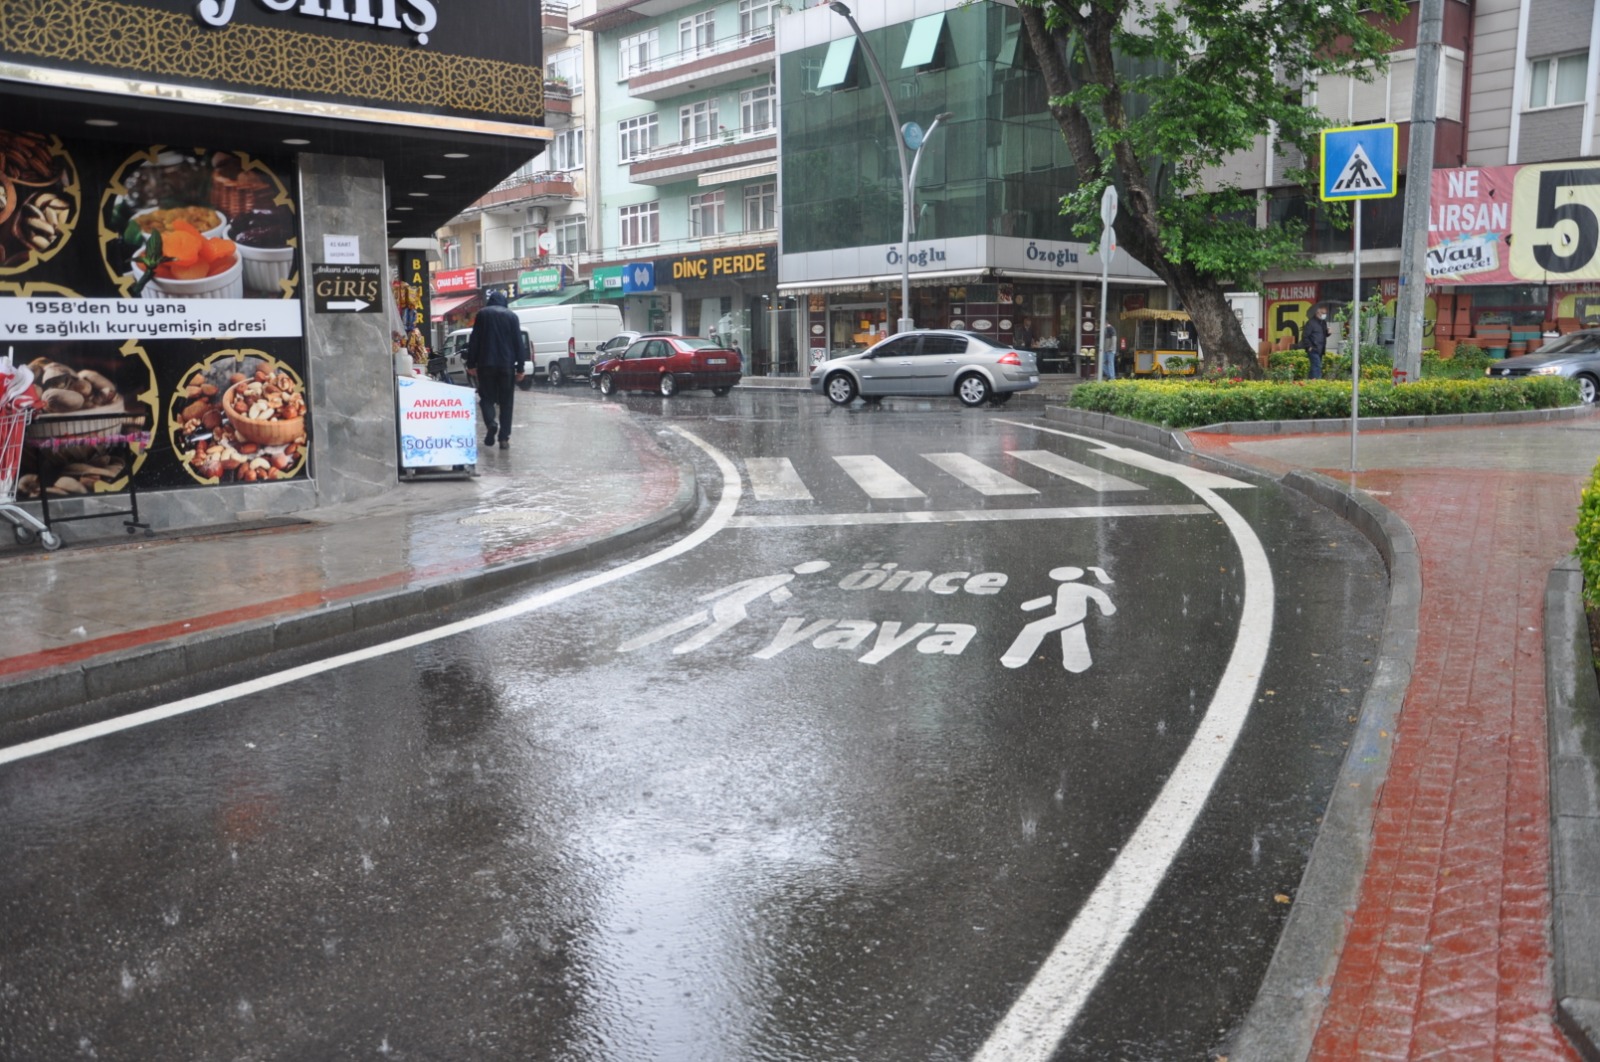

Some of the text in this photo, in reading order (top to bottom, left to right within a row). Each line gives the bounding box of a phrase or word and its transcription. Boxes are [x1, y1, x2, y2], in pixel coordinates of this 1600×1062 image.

[1448, 170, 1479, 198] NE
[1428, 203, 1508, 232] LIRSAN
[1533, 167, 1600, 273] 5
[673, 252, 766, 279] DİNÇ PERDE
[1026, 242, 1079, 267] Özoğlu
[1426, 245, 1483, 264] Vay
[313, 265, 380, 276] Ankara Kuruyemiş
[316, 276, 378, 302] GİRİŞ
[1280, 286, 1316, 300] ALIRSAN
[1385, 282, 1397, 296] NE
[26, 301, 186, 317] 1958'den bu yana
[5, 319, 266, 337] ve sağlıklı kuruyemişin adresi
[413, 398, 463, 408] ANKARA
[406, 435, 474, 450] SOĞUK SU
[838, 562, 1009, 595] önce
[752, 616, 978, 666] yaya
